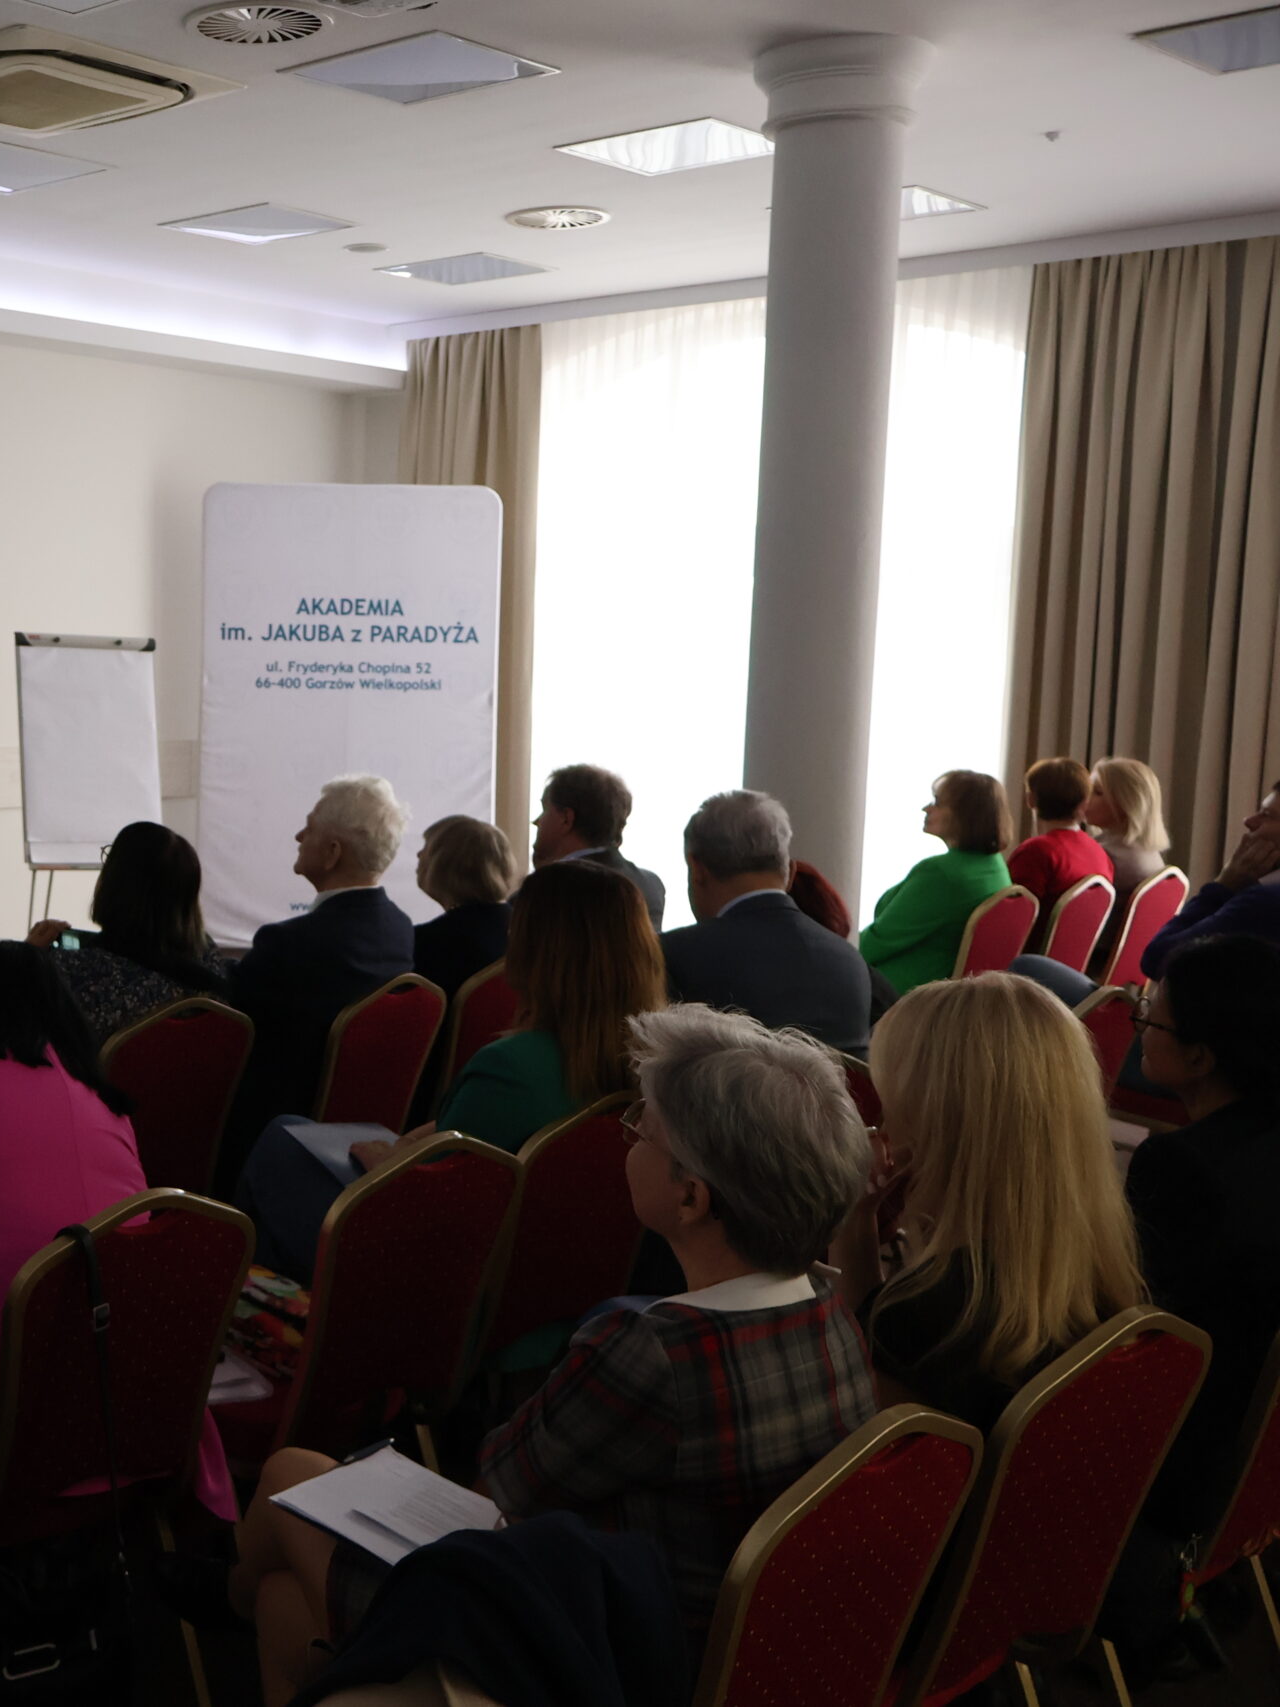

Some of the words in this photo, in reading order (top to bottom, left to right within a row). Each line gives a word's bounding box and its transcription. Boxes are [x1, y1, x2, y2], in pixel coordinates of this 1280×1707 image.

[296, 598, 404, 616] AKADEMIA
[220, 623, 252, 641] im.
[261, 624, 344, 642] JAKUBA
[351, 628, 362, 642] z
[371, 622, 479, 644] PARADYŻA
[266, 661, 282, 673] ul.
[288, 661, 354, 676] Fryderyka
[359, 662, 411, 676] Chopina
[416, 663, 431, 674] 52
[255, 677, 301, 689] 66-400
[306, 678, 355, 690] Gorzów
[360, 678, 442, 692] Wielkopolski
